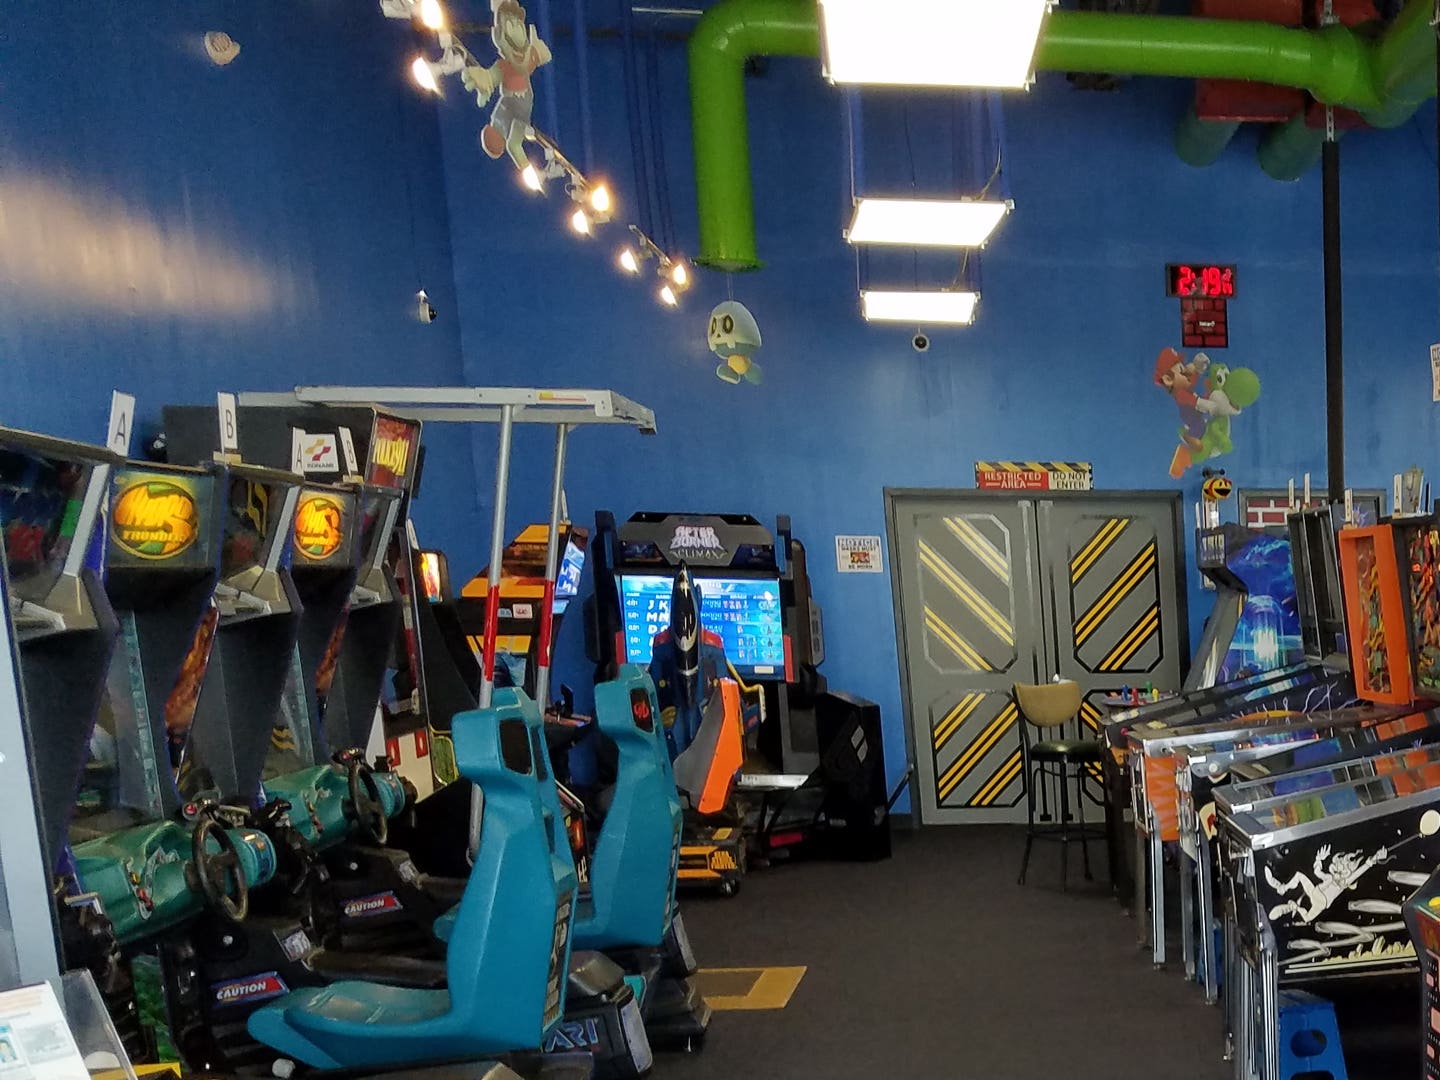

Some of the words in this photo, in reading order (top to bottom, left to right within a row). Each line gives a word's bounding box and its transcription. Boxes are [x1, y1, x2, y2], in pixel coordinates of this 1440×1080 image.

[114, 419, 127, 446] A
[226, 416, 234, 440] B
[296, 442, 303, 470] A
[984, 472, 1041, 481] RESTRICTED
[1001, 480, 1026, 488] AREA
[1053, 472, 1066, 480] DO
[1068, 472, 1086, 480] NOT
[1057, 481, 1084, 489] ENTER
[345, 899, 385, 915] CAUTION
[217, 981, 267, 1000] CAUTION
[545, 1018, 599, 1051] ARI
